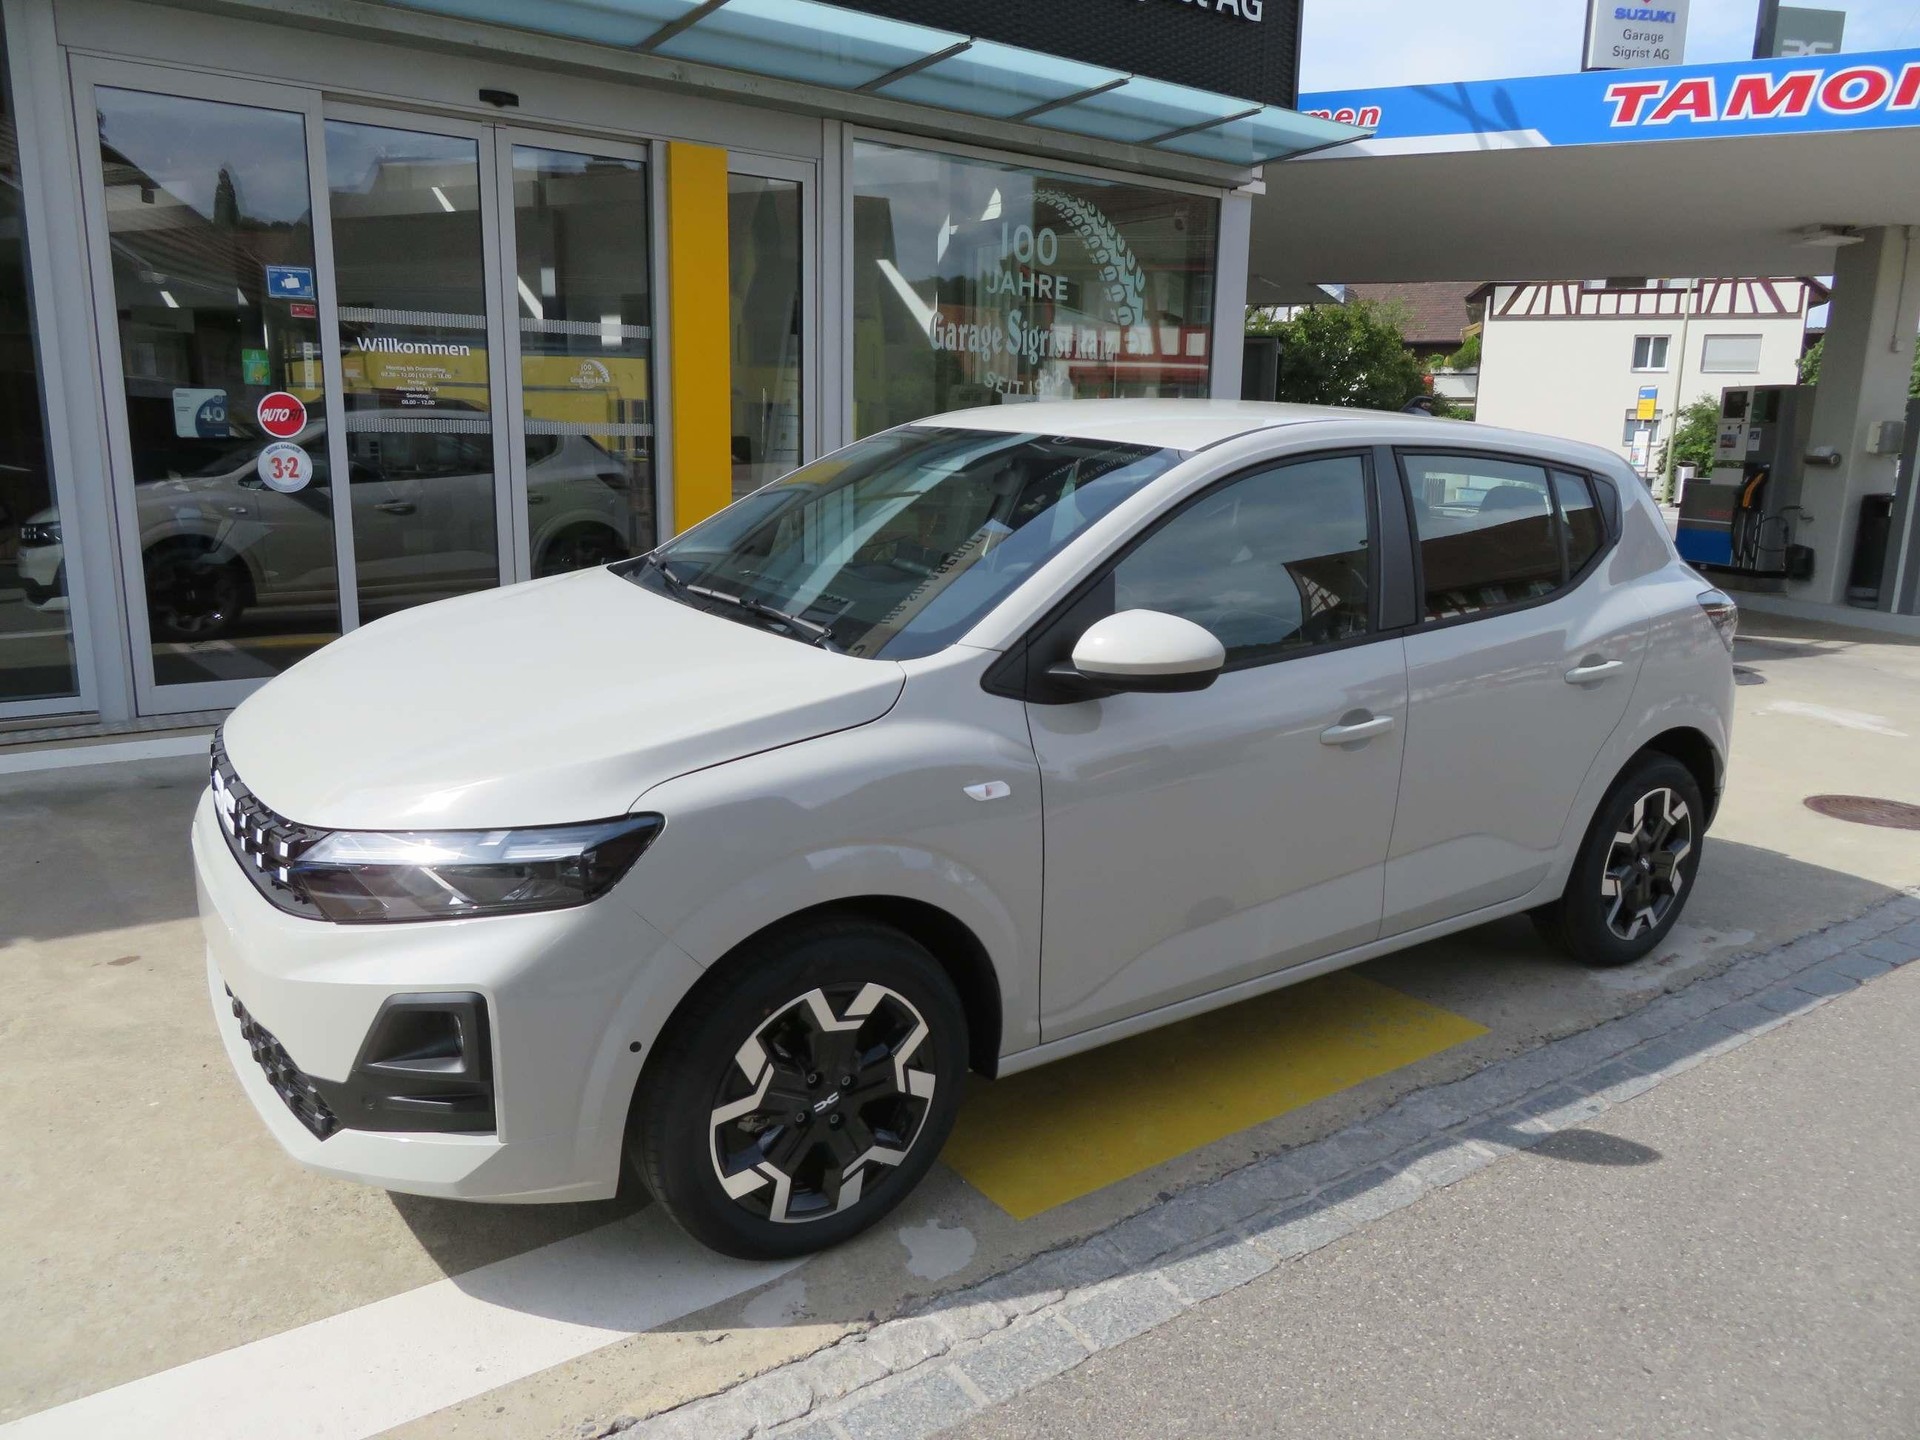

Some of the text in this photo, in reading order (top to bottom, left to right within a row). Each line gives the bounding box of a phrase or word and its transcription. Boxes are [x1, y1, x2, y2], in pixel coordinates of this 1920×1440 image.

[1614, 7, 1676, 23] SUZUKI
[1623, 28, 1664, 45] Garage
[1612, 45, 1670, 60] Sigrist AG
[1604, 63, 1920, 126] TAMOI
[1000, 221, 1058, 266] 100
[986, 270, 1068, 300] JAHRE
[929, 311, 1002, 361] Garage
[357, 337, 470, 356] Willkommen
[984, 371, 1024, 395] SEIT
[200, 406, 225, 422] 40
[1737, 424, 1743, 434] 1
